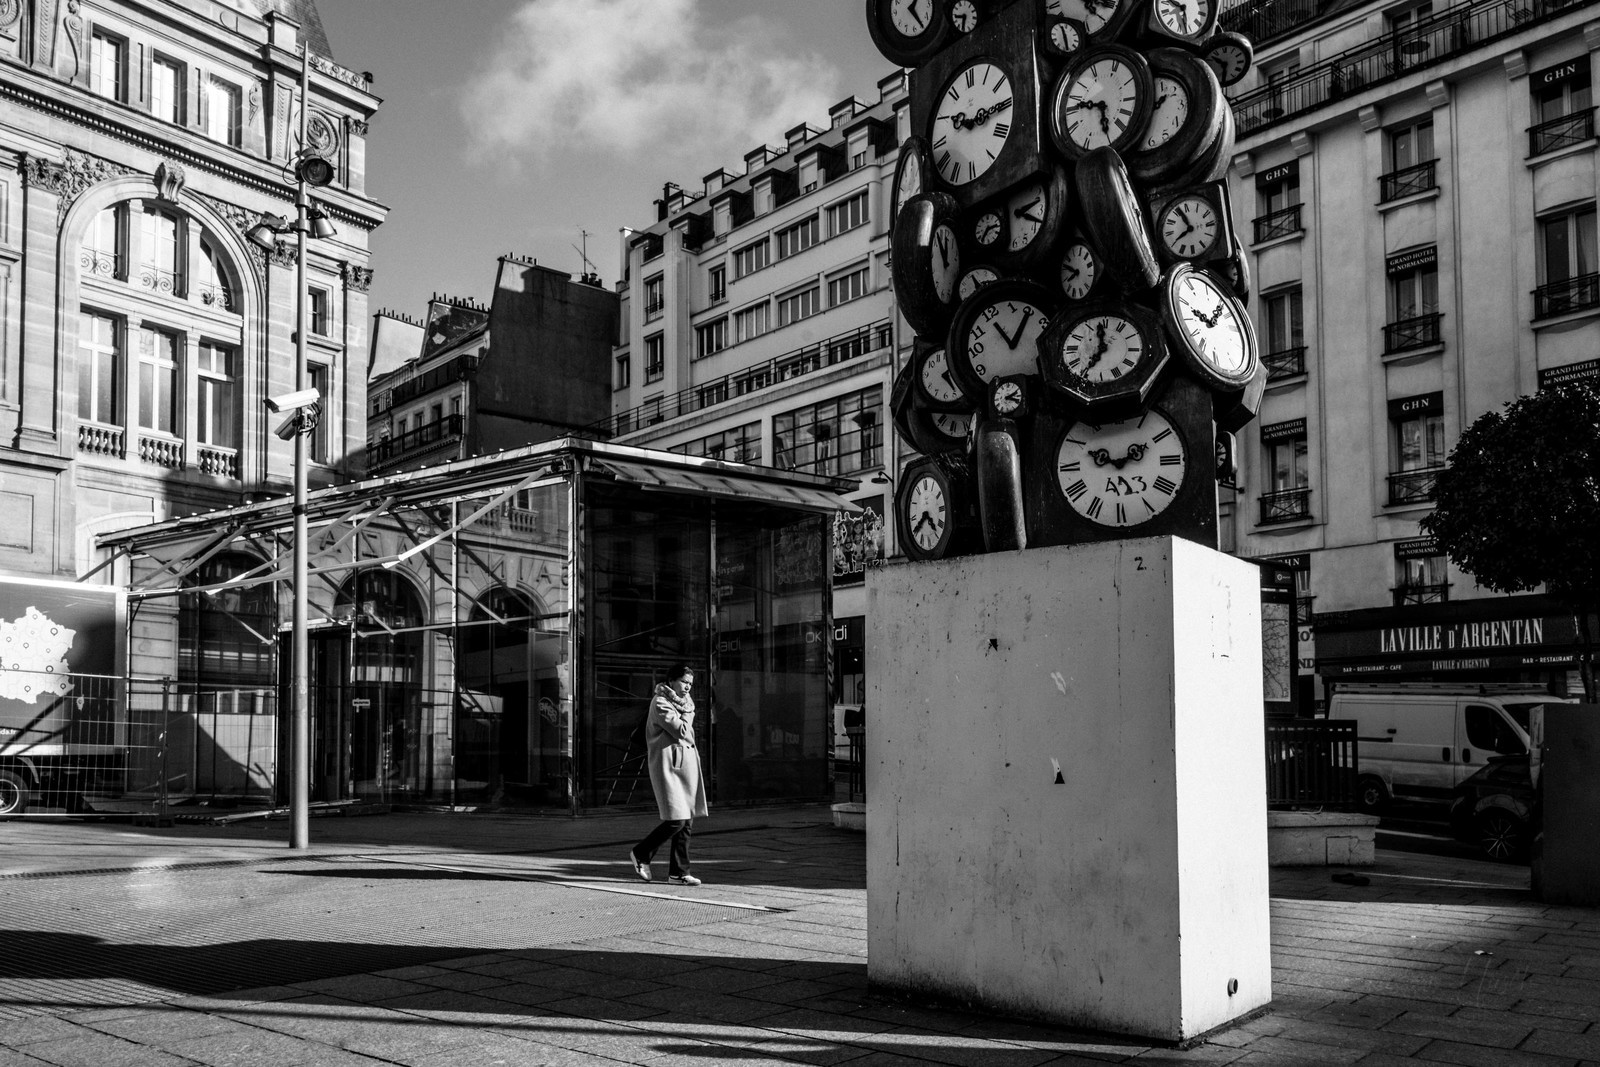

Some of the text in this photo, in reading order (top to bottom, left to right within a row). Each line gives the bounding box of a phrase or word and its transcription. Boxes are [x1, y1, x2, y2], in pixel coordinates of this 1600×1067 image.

[1544, 63, 1576, 83] GHN
[1265, 166, 1289, 181] GHN
[1389, 248, 1434, 266] GRAND HOTEL
[1396, 255, 1436, 271] NORMANDIE
[982, 306, 999, 322] 12
[1007, 302, 1018, 313] 1
[1038, 317, 1050, 330] 3
[970, 325, 986, 341] 11
[968, 342, 984, 358] 10
[975, 364, 986, 376] 9
[1545, 361, 1598, 377] GRAND HOTEL
[1553, 369, 1599, 383] NORMANDIE
[1402, 398, 1429, 411] GHN
[1264, 420, 1303, 433] GRAND HOTEL
[1271, 426, 1304, 438] NORMANDIE
[1539, 655, 1574, 663] RESTAURANT
